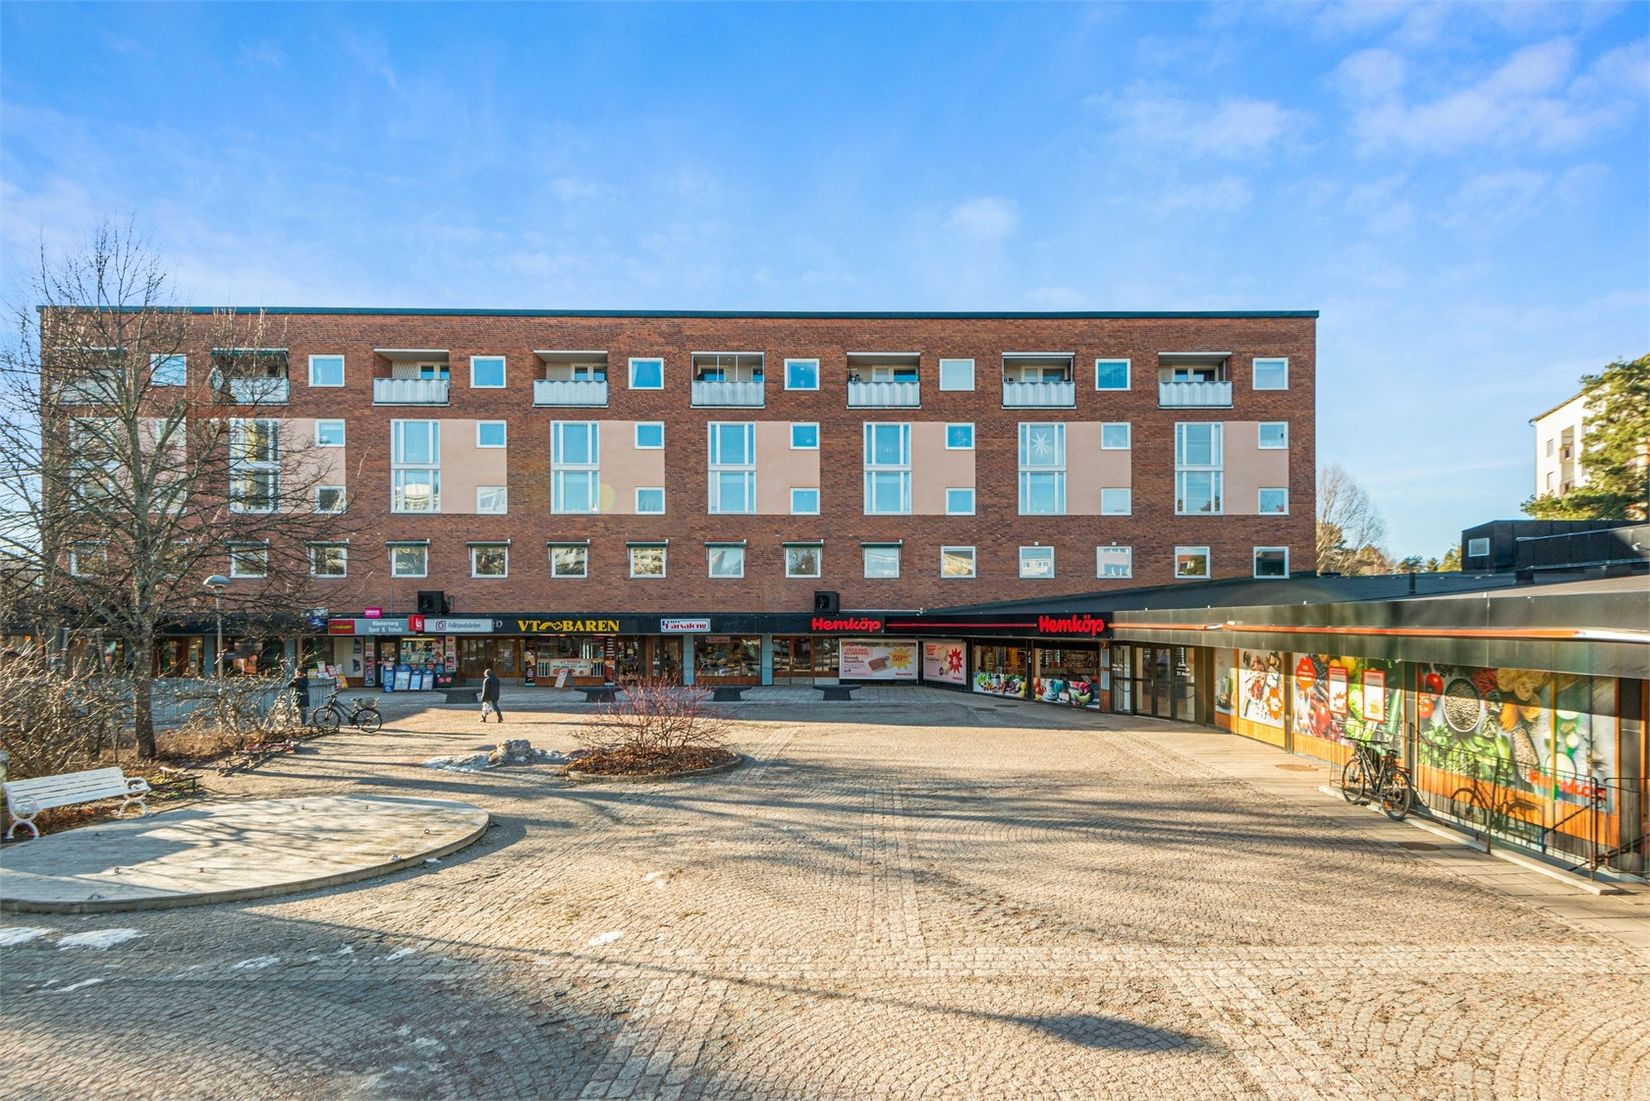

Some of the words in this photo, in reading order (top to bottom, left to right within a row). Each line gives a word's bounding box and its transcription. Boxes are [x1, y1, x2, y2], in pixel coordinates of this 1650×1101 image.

[517, 620, 540, 632] VT
[562, 620, 620, 632] BAREN
[811, 617, 881, 632] Hemköp
[1038, 614, 1104, 637] Hemköp
